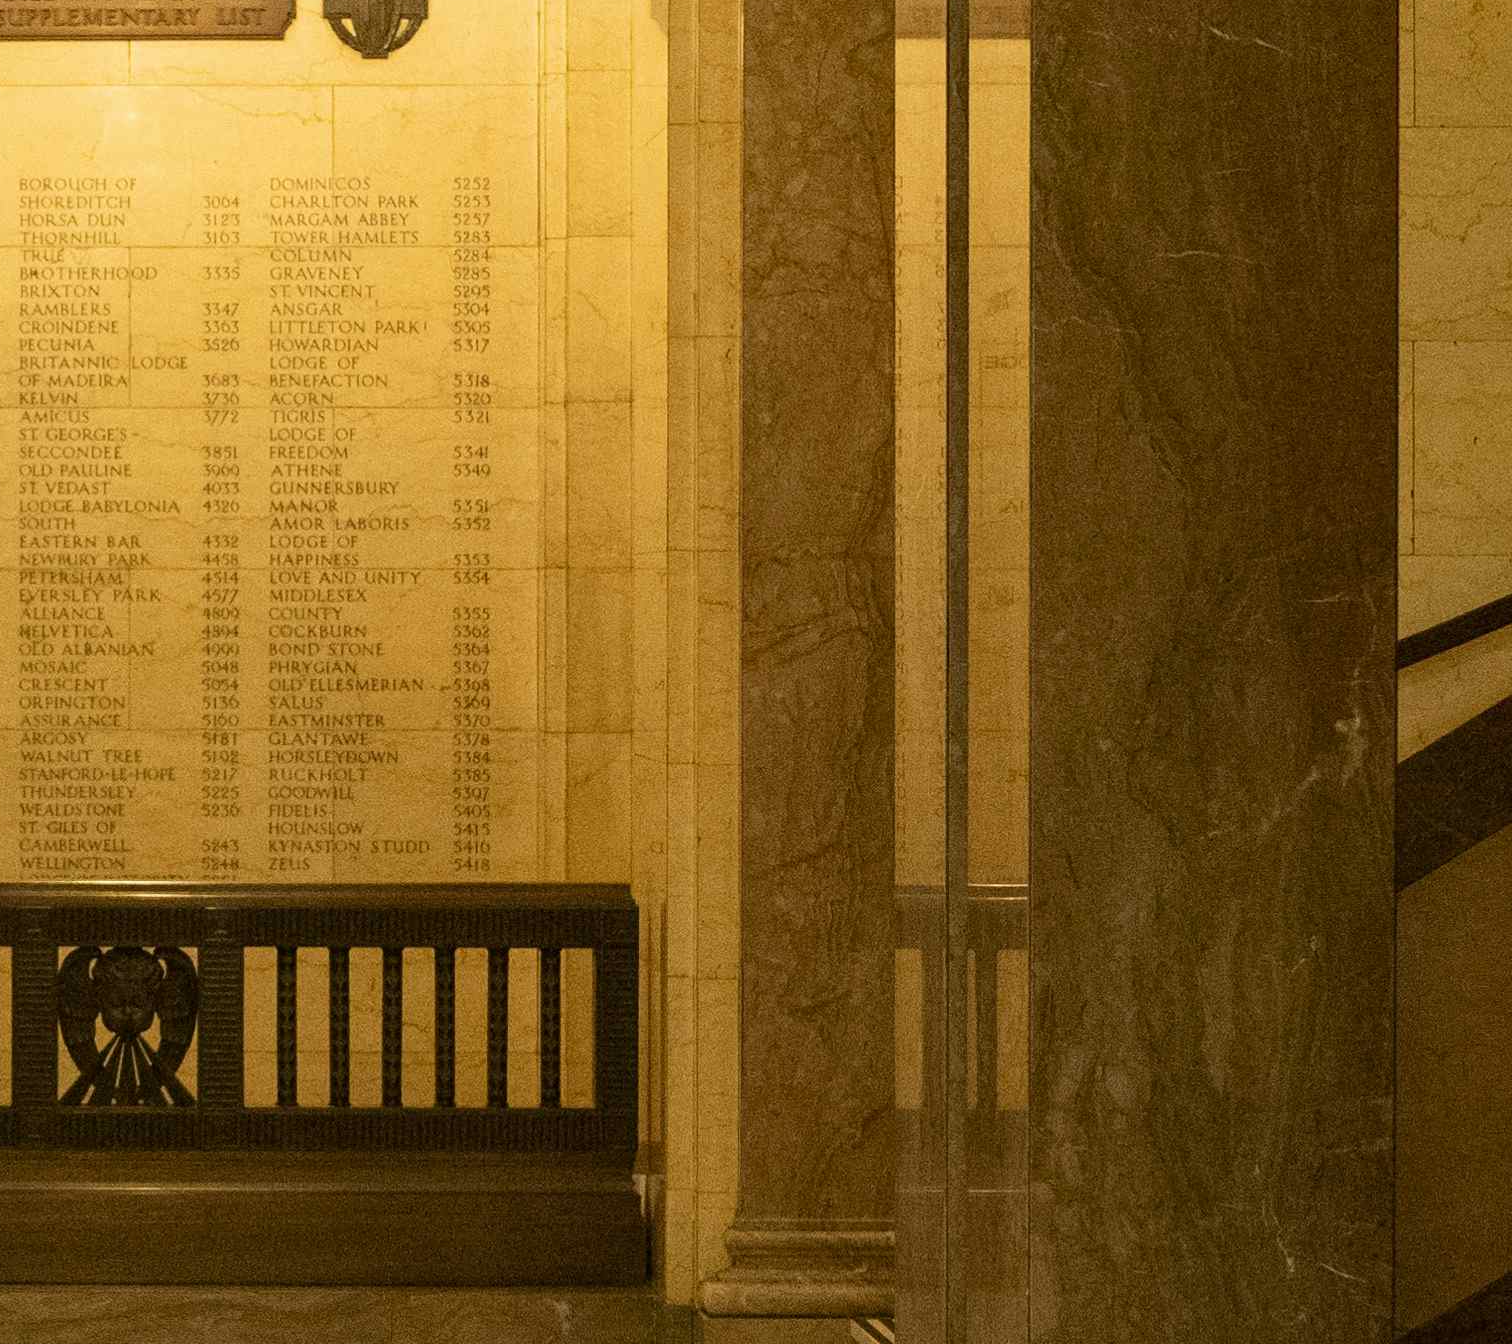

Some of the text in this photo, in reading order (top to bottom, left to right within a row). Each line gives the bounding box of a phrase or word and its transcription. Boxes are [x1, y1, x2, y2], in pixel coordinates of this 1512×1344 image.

[216, 9, 266, 26] LIST
[19, 178, 136, 191] BOROUGH OF
[270, 177, 490, 191] DOMINICOS 5252
[19, 196, 131, 209] SHOREDITCH
[270, 195, 490, 208] CHARLTON PARK 5253
[19, 213, 240, 226] HORSA DUN 3123
[270, 213, 490, 226] MARGAM ABBEY 5257
[21, 232, 121, 245] THORNHILL
[271, 231, 329, 244] TOWER
[339, 231, 419, 244] HAMLETS
[270, 267, 364, 280] GRAVENEY
[20, 285, 100, 298] BRIXTON
[19, 303, 111, 316] RAMBLERS
[271, 303, 344, 316] ANSGAR
[19, 321, 119, 334] CROINDENE
[19, 356, 188, 370] BRITANNIC LODGE
[269, 356, 359, 370] LODGE OF
[18, 374, 128, 387] OF MADEIRA
[269, 374, 490, 388] BENEFACTION 5318
[269, 446, 348, 459] FREEDOM
[271, 464, 342, 477] ATHENE
[269, 482, 400, 495] GUNNERSBURY
[268, 678, 424, 692] OLD ELLESMERIAN
[268, 840, 430, 854] KYNASTON STUDD
